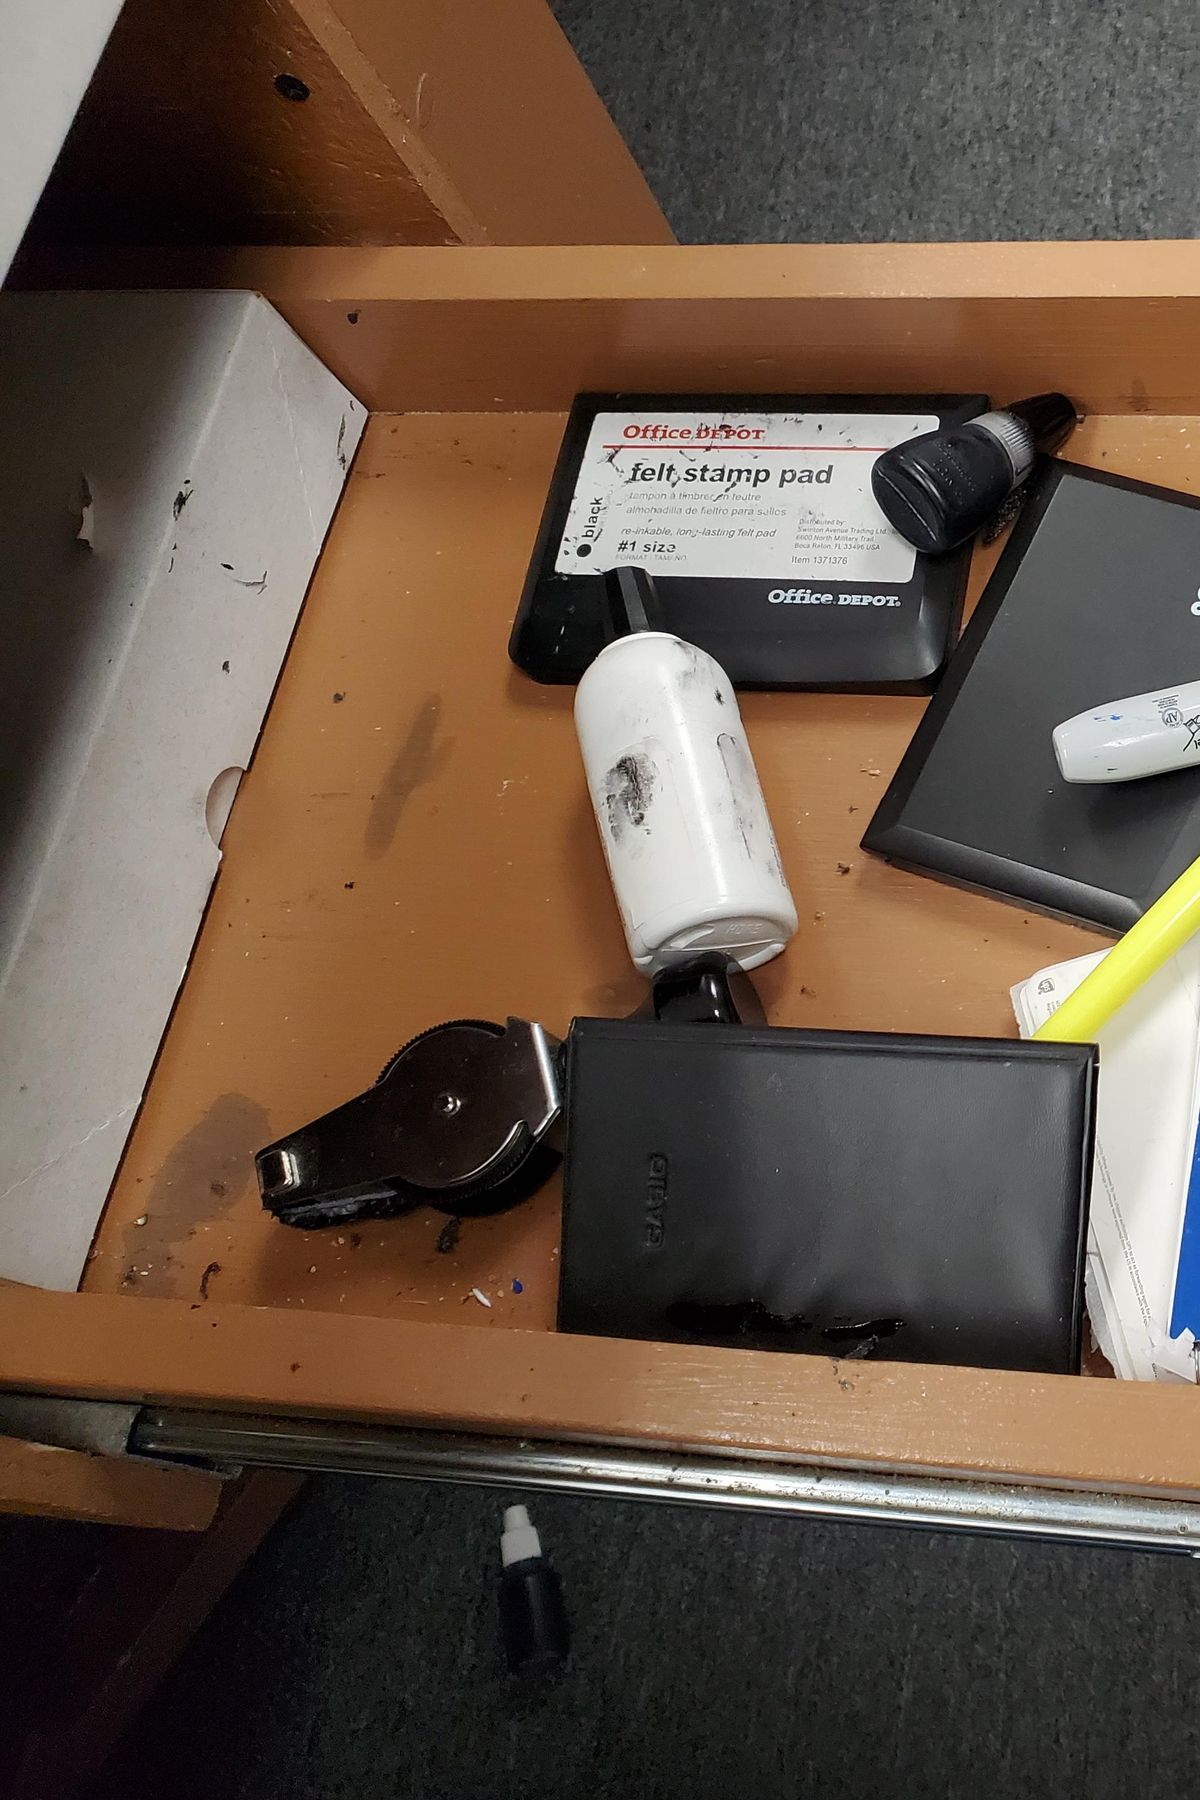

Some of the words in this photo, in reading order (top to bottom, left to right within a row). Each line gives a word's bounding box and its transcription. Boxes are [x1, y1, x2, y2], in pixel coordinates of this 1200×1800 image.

[624, 425, 691, 440] Office
[696, 427, 765, 440] DEPOT
[630, 463, 676, 482] felt
[683, 463, 771, 487] stamp
[779, 465, 834, 488] pad
[581, 497, 603, 538] black
[685, 507, 698, 515] de
[620, 527, 673, 536] re-inkable,
[755, 529, 777, 538] pad
[617, 540, 637, 552] #1
[643, 541, 676, 553] size
[791, 555, 810, 564] Item
[813, 556, 848, 565] 1371376
[768, 589, 834, 604] Office
